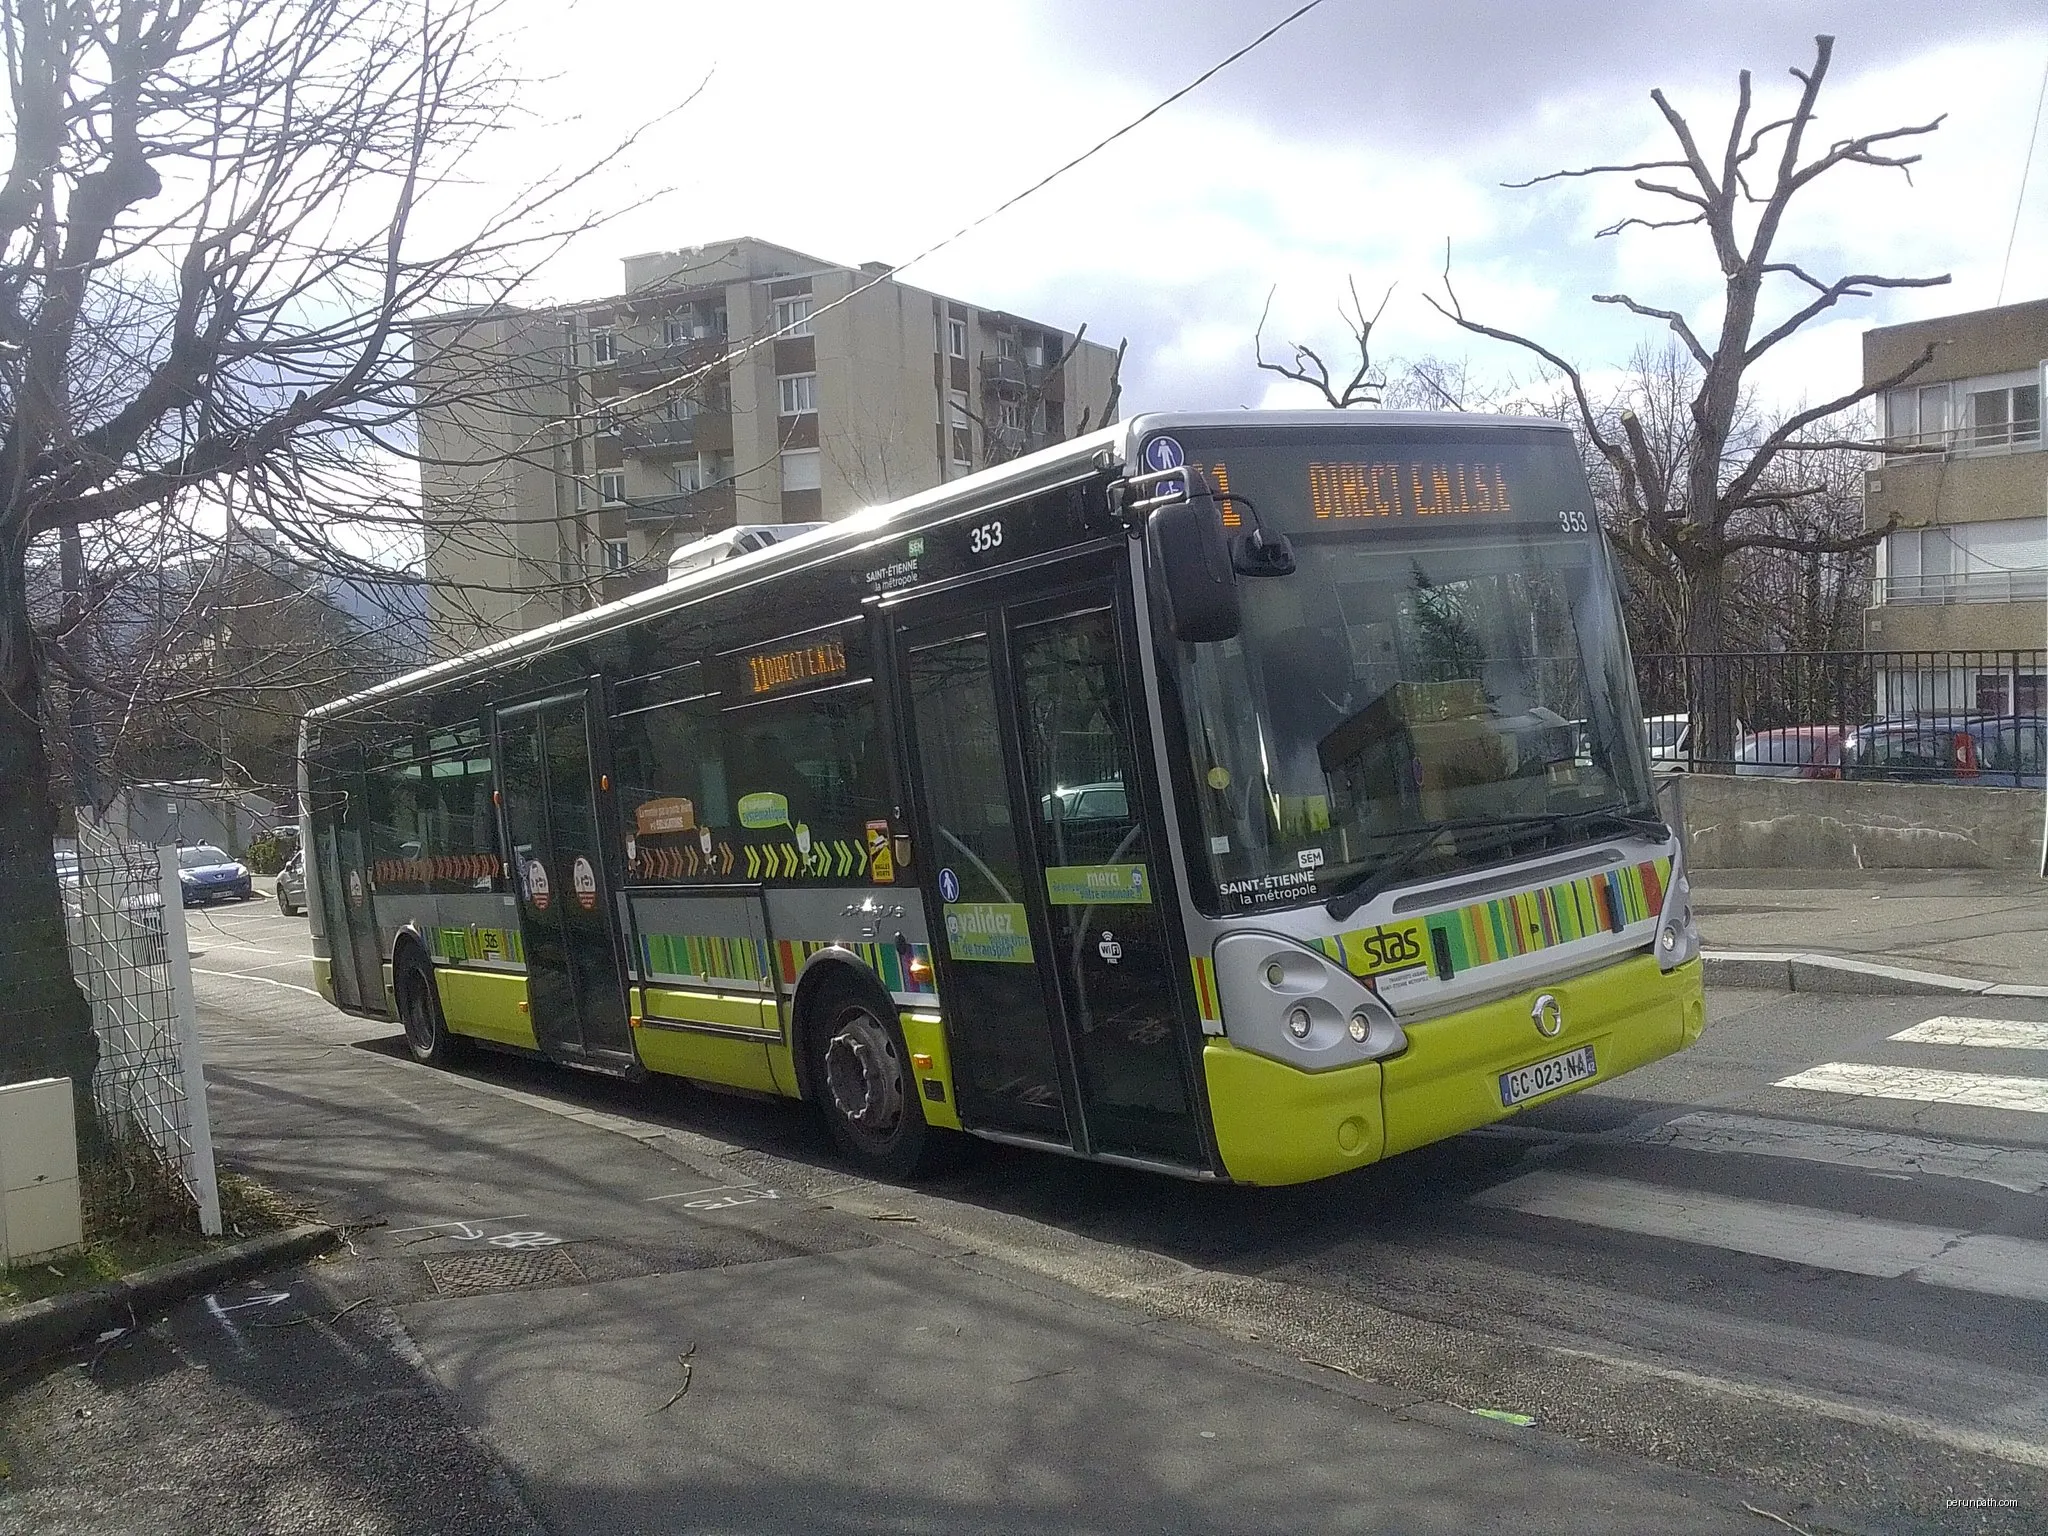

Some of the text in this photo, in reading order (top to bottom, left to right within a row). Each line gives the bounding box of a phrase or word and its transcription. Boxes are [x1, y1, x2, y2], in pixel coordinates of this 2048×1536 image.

[1308, 462, 1403, 518] DIRECT
[1558, 511, 1588, 533] 353
[970, 521, 1003, 553] 353
[865, 559, 918, 583] SAINT-ÉTIENNE
[874, 571, 918, 591] la métropole
[764, 651, 805, 685] DIRECT
[1087, 867, 1120, 887] merci
[1219, 871, 1316, 895] SAINT-ÉTIENNE
[1240, 884, 1318, 905] la métropole
[958, 906, 1014, 934] validez
[1363, 925, 1421, 969] stas
